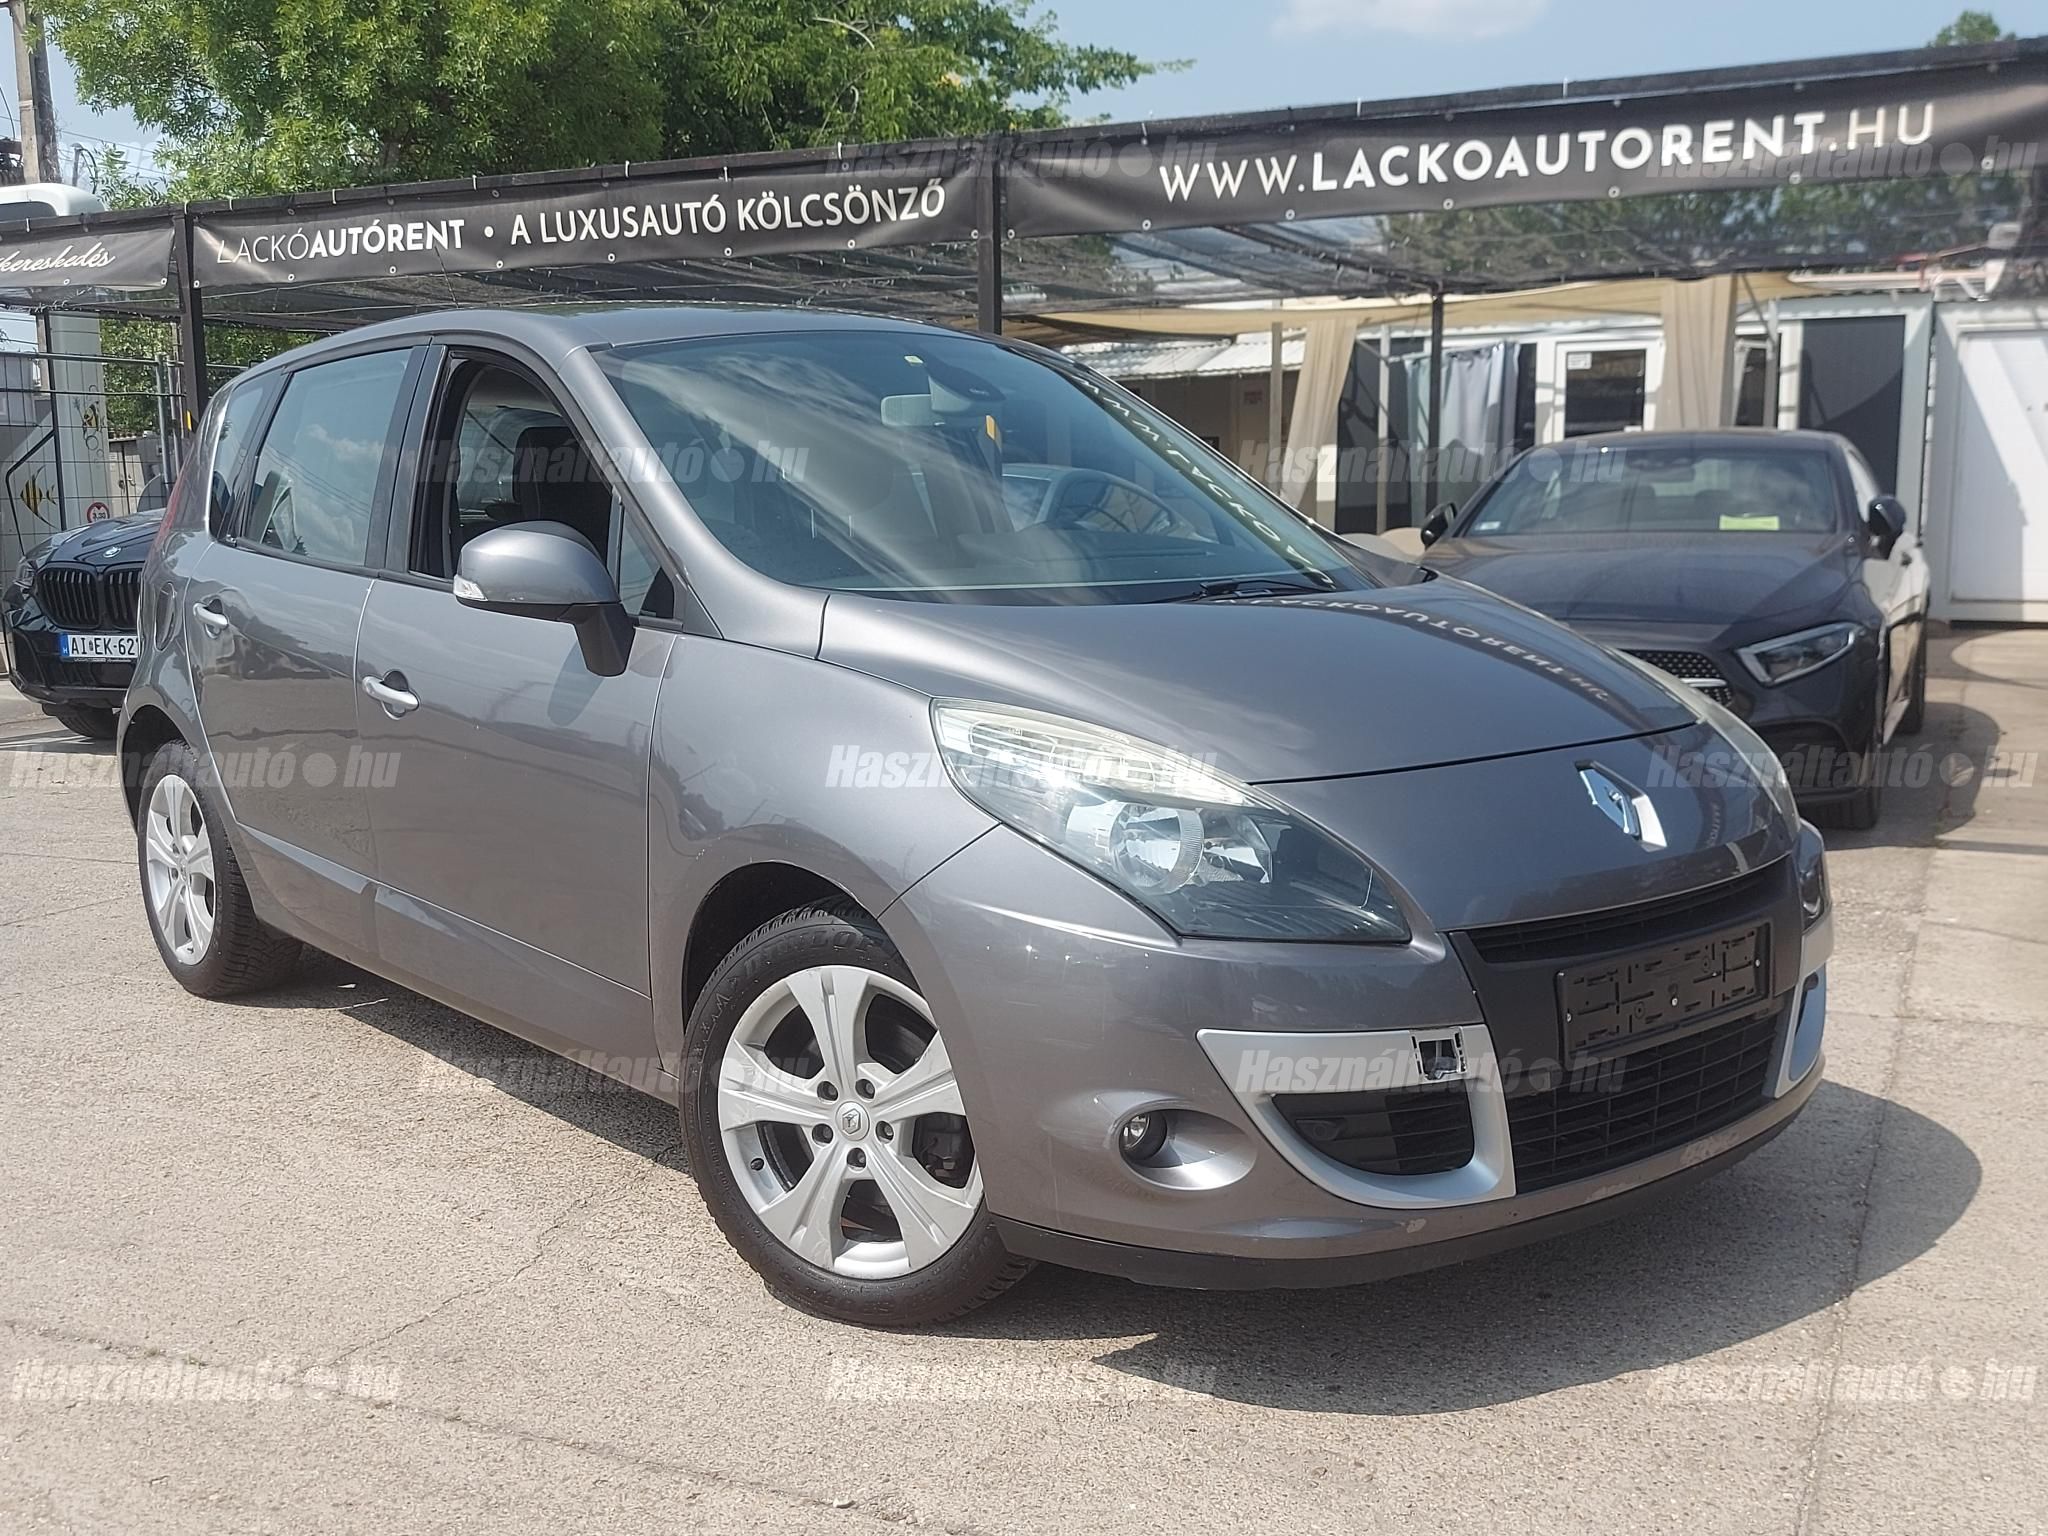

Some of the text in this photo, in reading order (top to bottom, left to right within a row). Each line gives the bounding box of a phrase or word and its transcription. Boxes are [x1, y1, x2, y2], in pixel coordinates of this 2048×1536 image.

[1159, 102, 1934, 203] WWW.LACKOAUTORENT.HU
[217, 178, 946, 264] LACKÓAUTÓRENT A LUXUSAUTÓ KÖLCSÖNZŐ
[0, 242, 115, 272] kereskedés
[94, 637, 139, 656] EK-62
